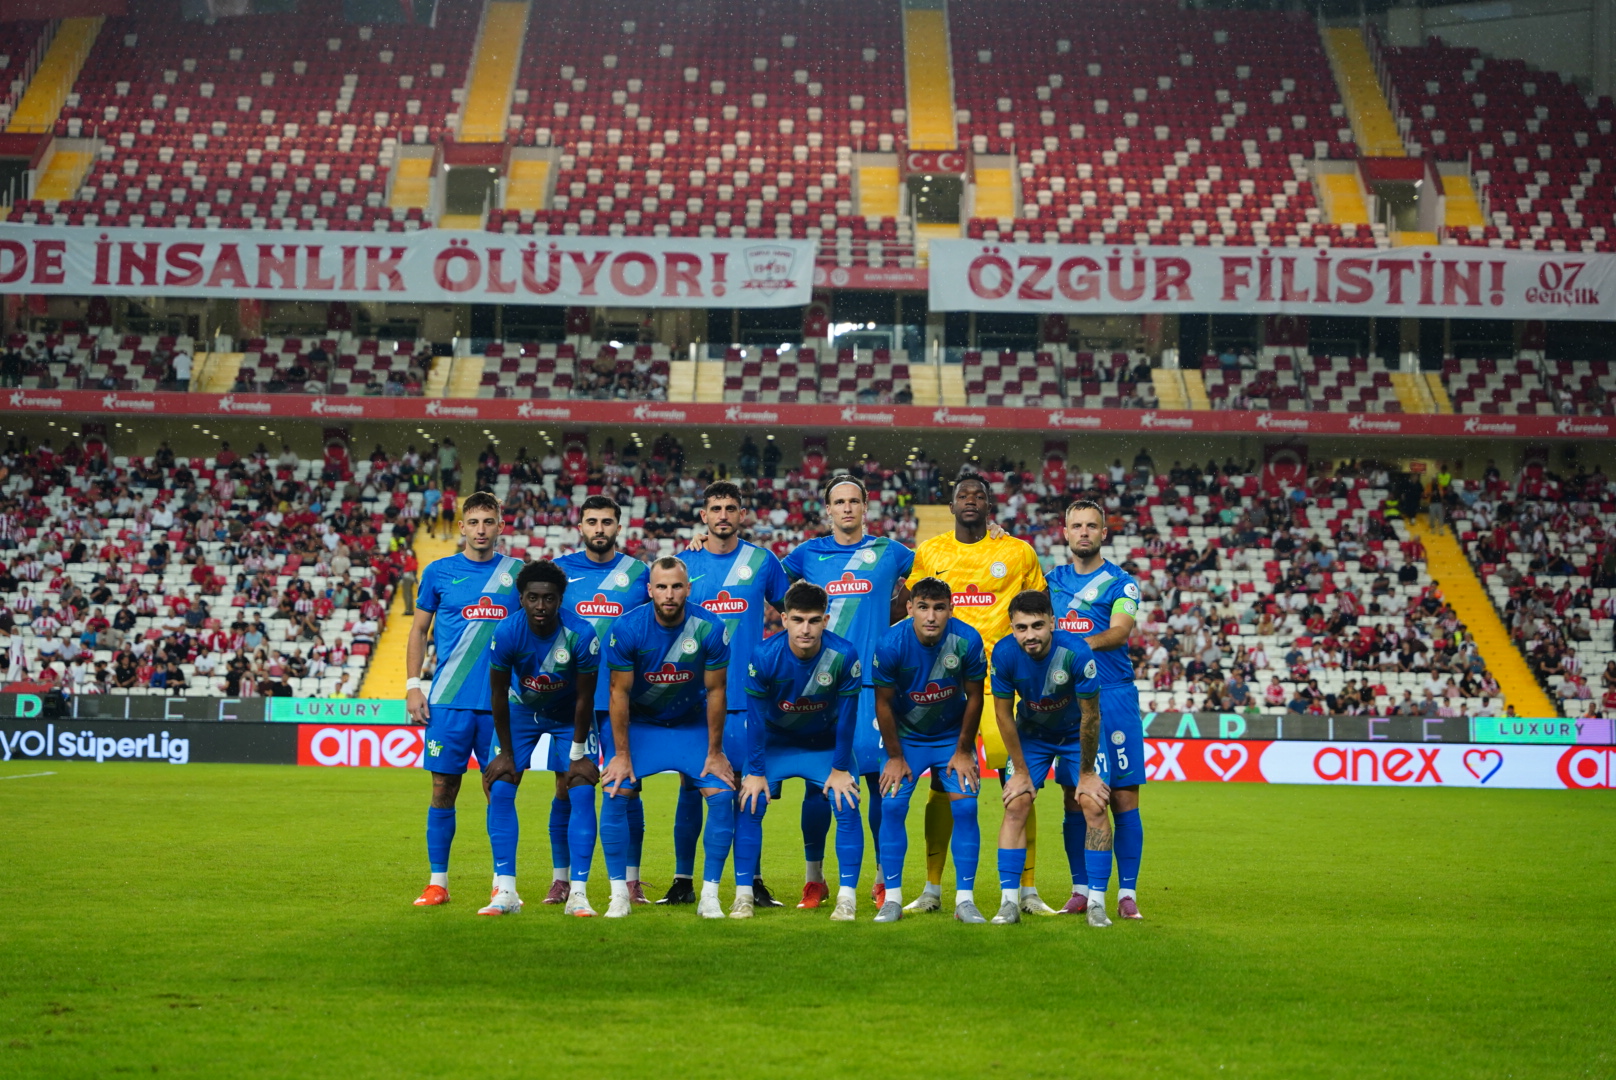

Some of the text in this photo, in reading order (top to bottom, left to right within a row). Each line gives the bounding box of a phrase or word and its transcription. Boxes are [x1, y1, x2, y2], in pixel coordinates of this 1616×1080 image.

[0, 233, 729, 298] DE İNSANLIK ÖLÜYOR!
[968, 246, 1507, 307] ÖZGÜR FİLİSTİN!
[1538, 261, 1586, 291] 07
[829, 582, 868, 593] ÇAYKUR
[466, 607, 504, 619] ÇAYKUR
[580, 604, 619, 614] ÇAYKUR
[296, 703, 382, 716] LUXURY
[1500, 722, 1584, 736] LUXURY
[1116, 747, 1129, 770] 5
[1313, 747, 1443, 784] anex
